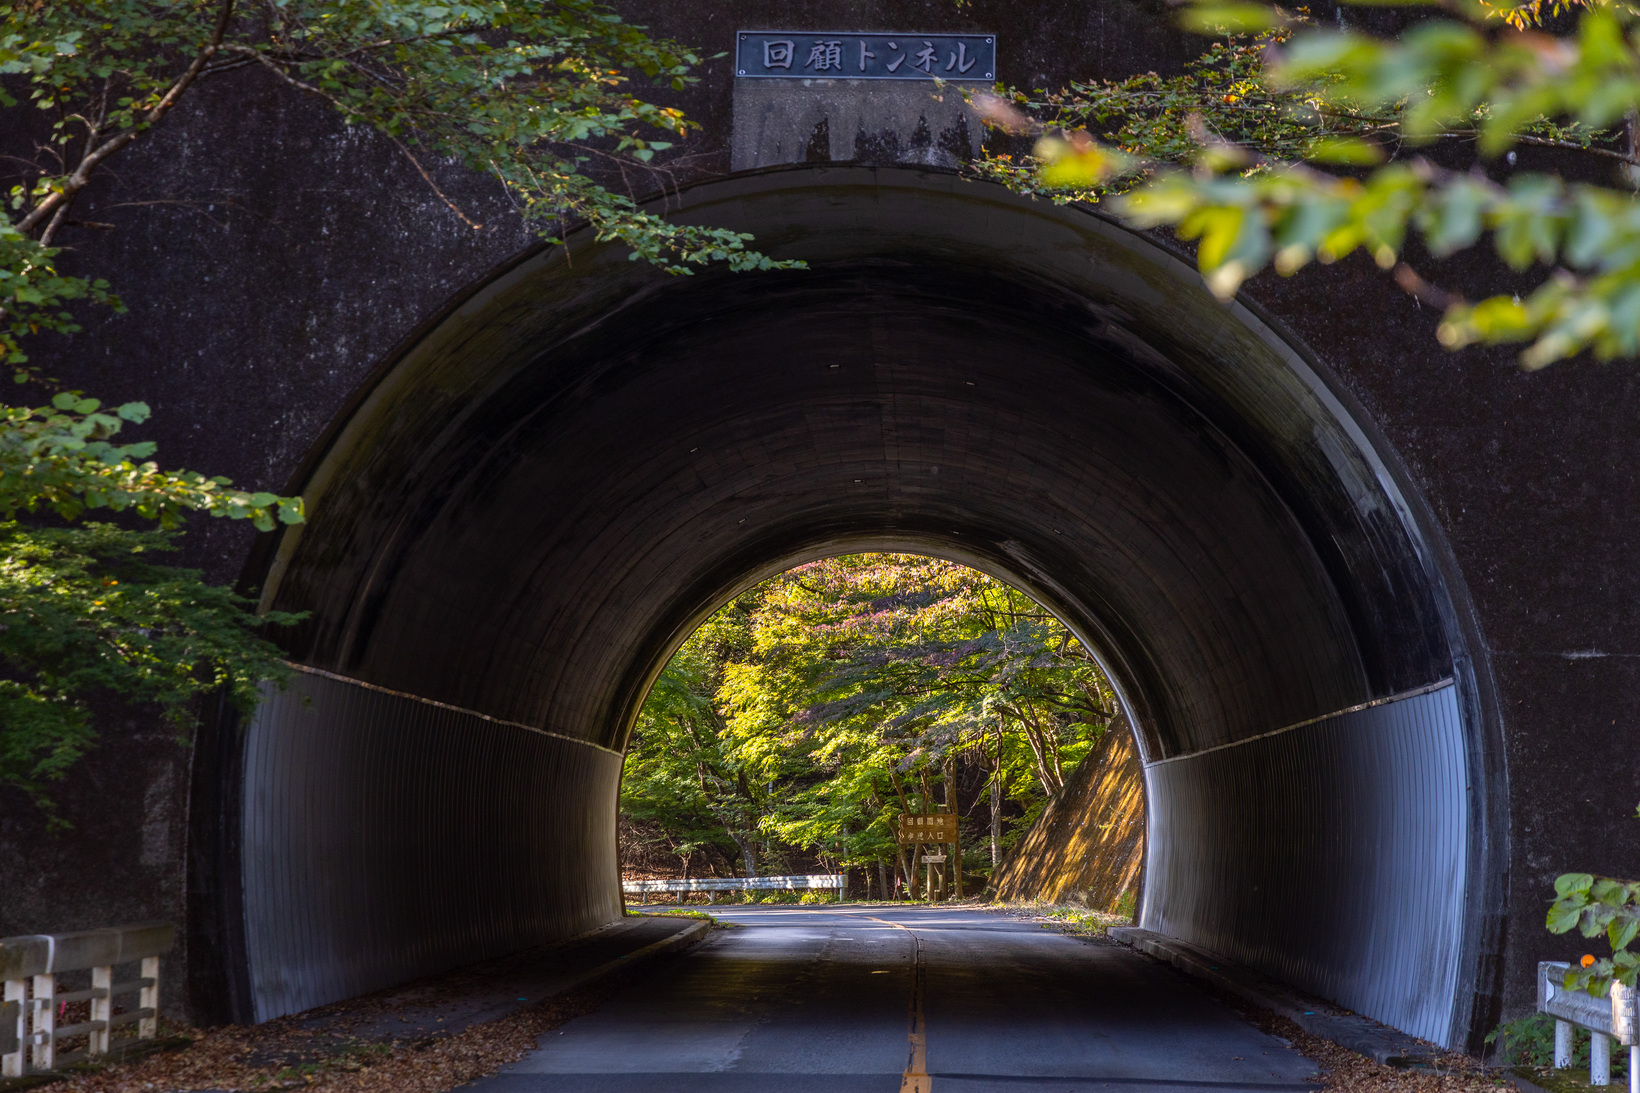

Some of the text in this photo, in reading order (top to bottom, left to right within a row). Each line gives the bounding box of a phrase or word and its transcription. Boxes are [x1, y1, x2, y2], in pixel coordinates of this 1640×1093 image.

[763, 39, 976, 73] 回顧トンネル
